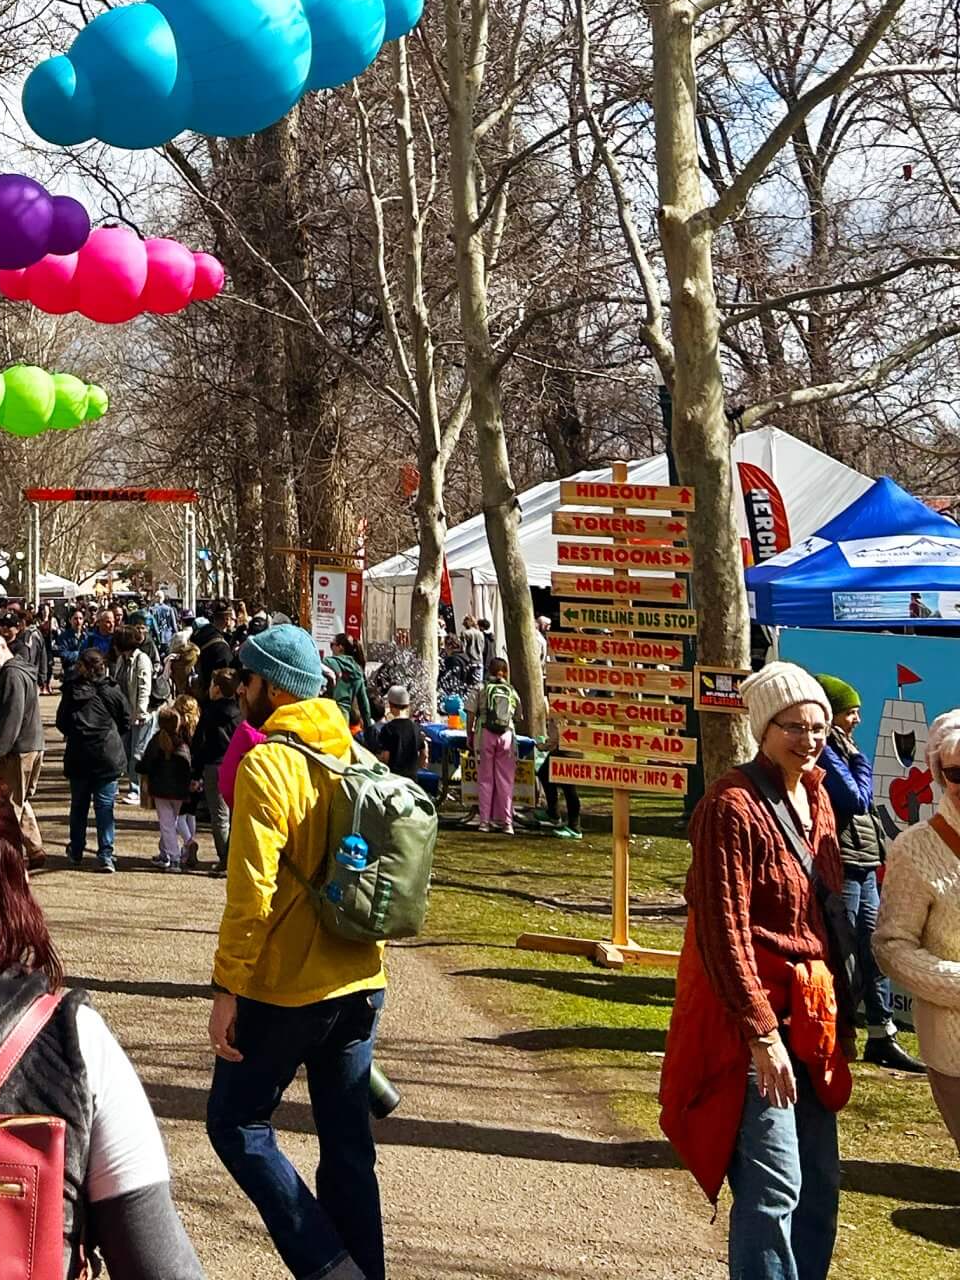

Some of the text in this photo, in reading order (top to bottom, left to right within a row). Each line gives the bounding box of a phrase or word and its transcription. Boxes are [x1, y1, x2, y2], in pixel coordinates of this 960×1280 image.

[576, 484, 658, 500] HIDEOUT
[572, 517, 647, 533] TOKENS
[751, 488, 777, 558] MERCH
[558, 546, 673, 565] RESTROOMS
[576, 578, 640, 594] MERCH
[580, 609, 696, 628] TREELINE BUS STOP
[548, 636, 662, 656] WATER STATION
[566, 667, 646, 687] KIDFORT
[571, 700, 684, 723] LOST CHILD
[593, 732, 684, 753] FIRST-AID
[551, 761, 591, 779] RANGER
